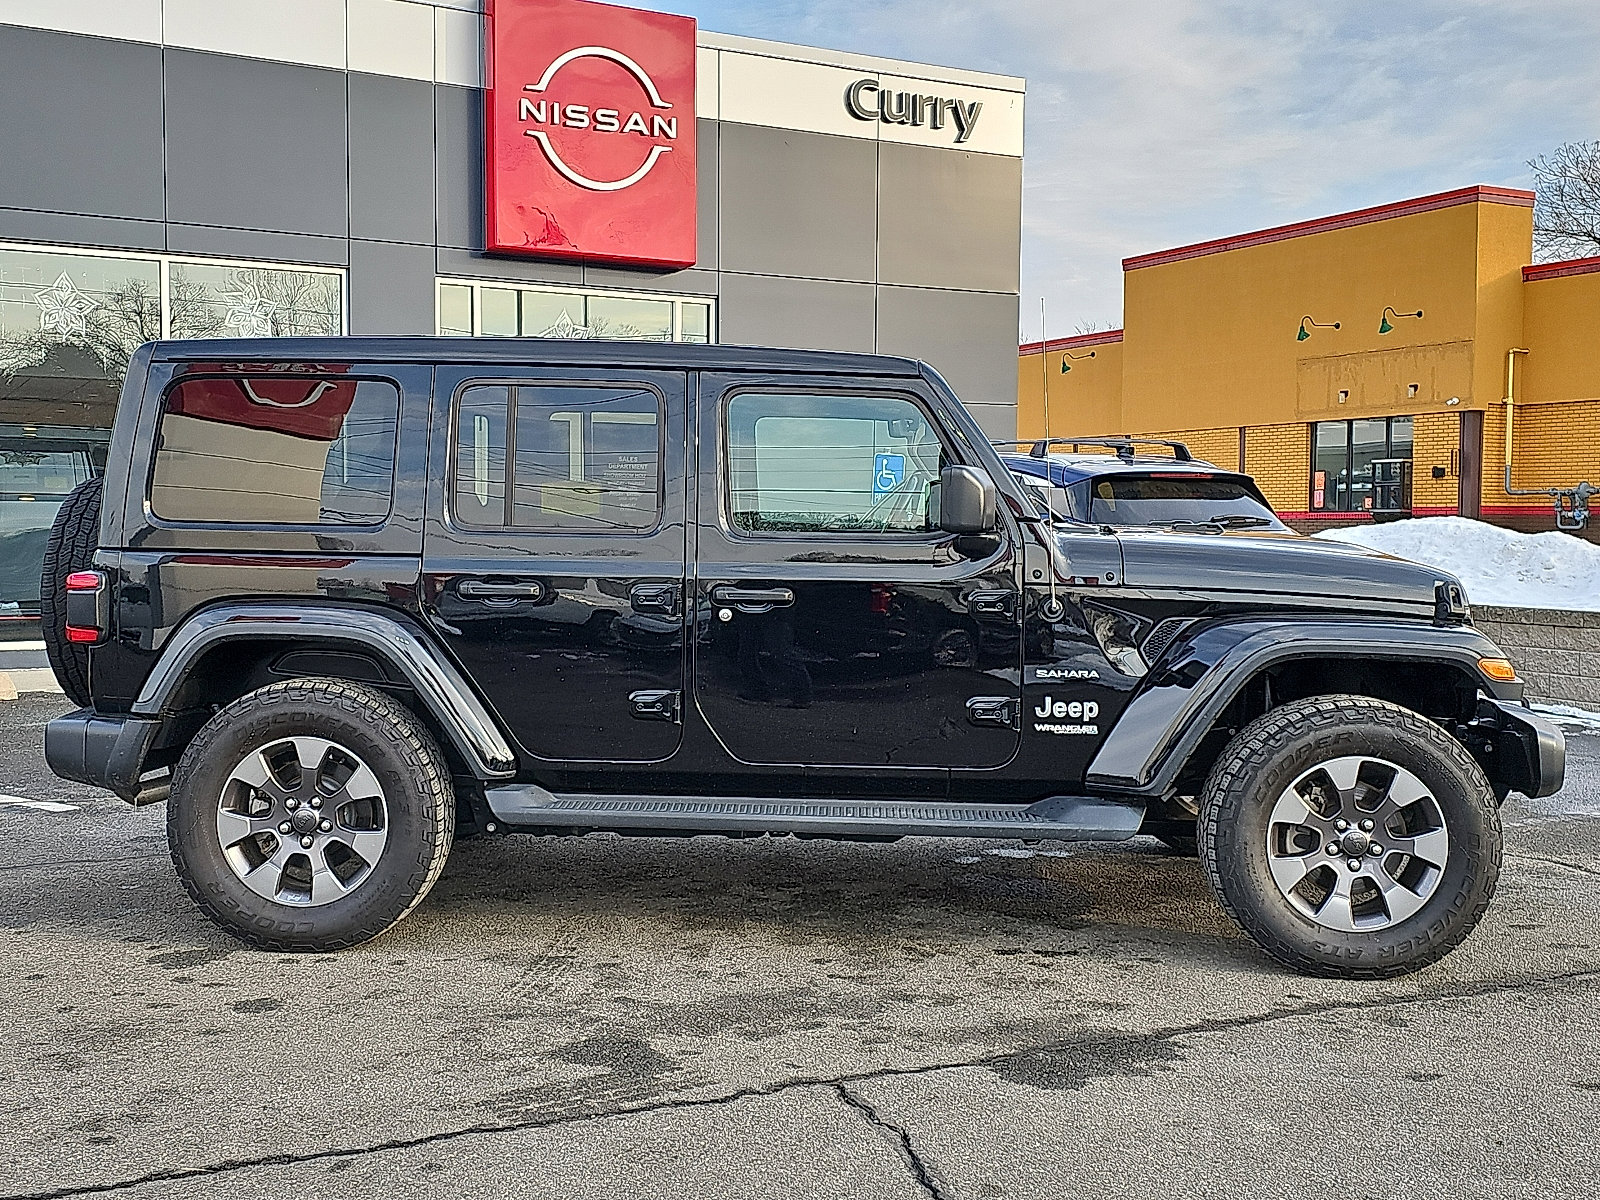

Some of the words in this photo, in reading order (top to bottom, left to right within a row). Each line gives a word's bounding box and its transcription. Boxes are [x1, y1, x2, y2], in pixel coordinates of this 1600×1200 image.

[519, 97, 677, 139] NISSAN
[844, 79, 983, 143] Curry
[1036, 669, 1100, 679] SAHARA
[1034, 696, 1099, 722] Jeep
[1034, 723, 1098, 734] WRANGLER
[207, 881, 314, 934] COOPER
